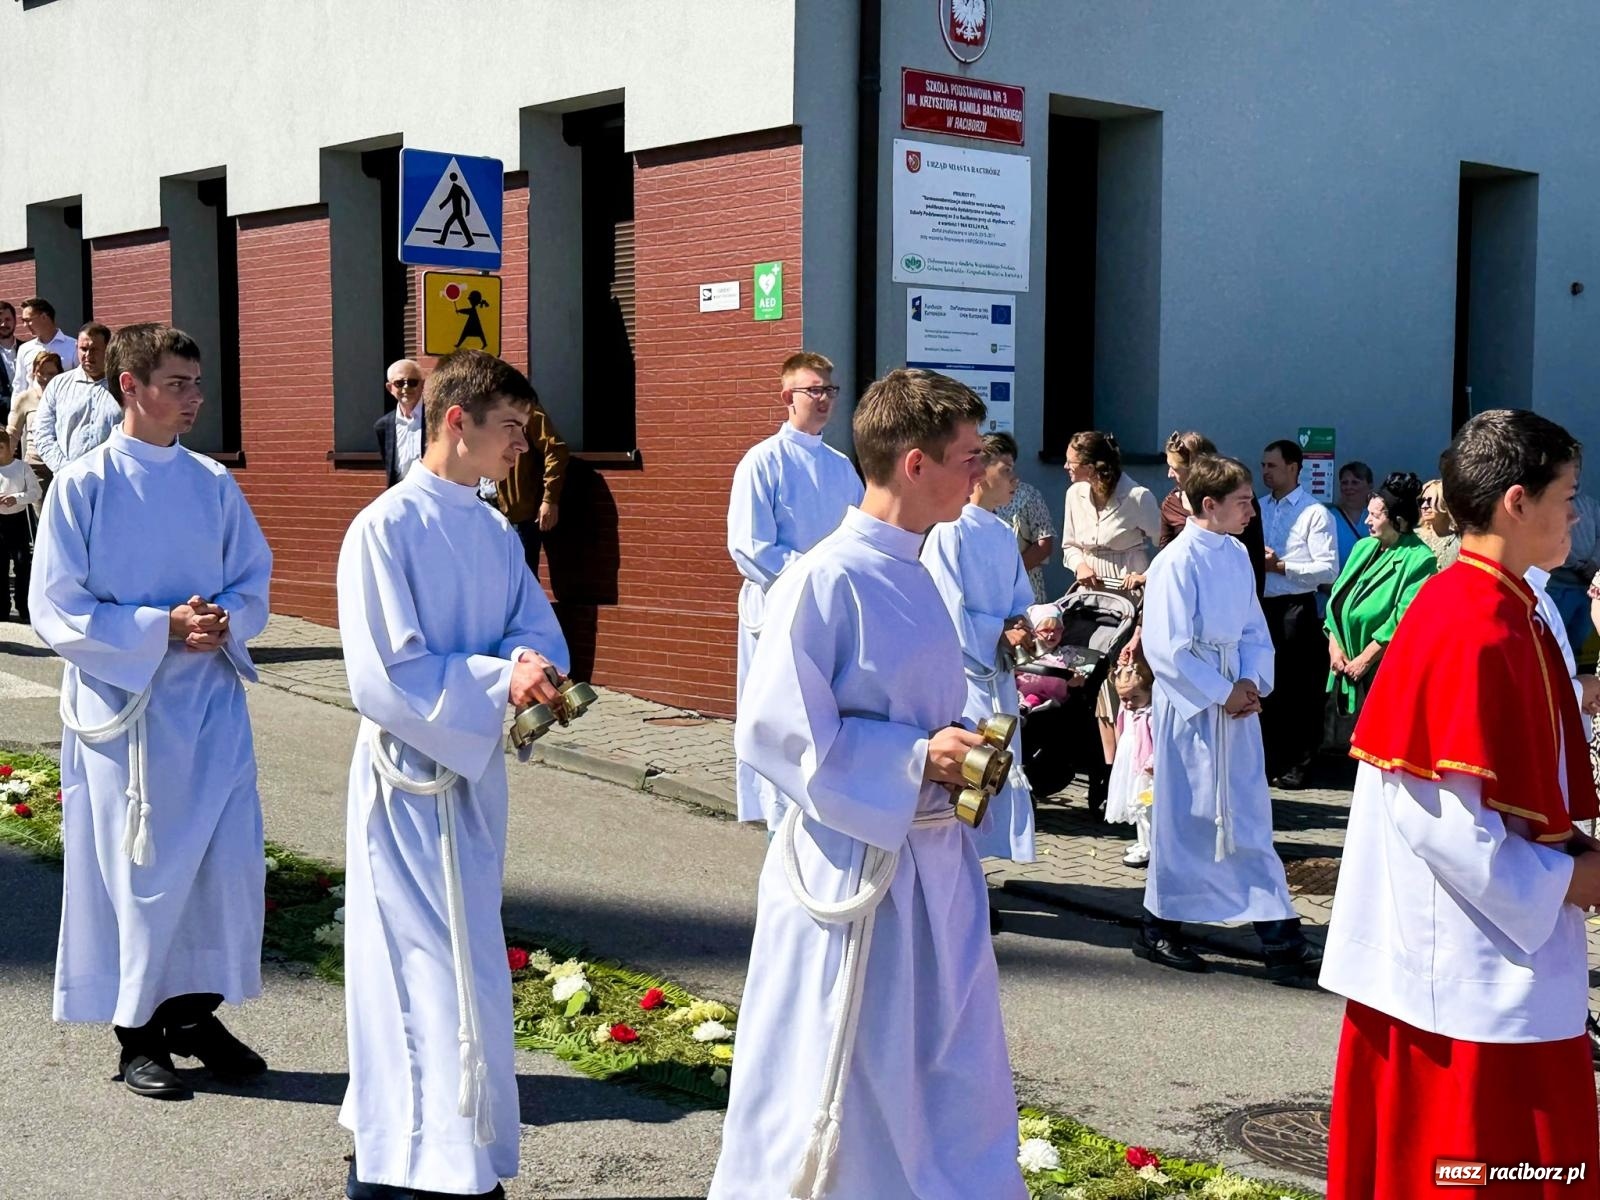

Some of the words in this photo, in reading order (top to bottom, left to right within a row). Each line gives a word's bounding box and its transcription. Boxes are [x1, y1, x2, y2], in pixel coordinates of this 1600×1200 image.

[925, 79, 949, 94] SZKOŁA
[950, 83, 992, 101] PODSTAWOWA
[993, 91, 1002, 103] NR
[907, 94, 918, 106] IM.
[919, 95, 957, 112] KRZYSZTOFA
[959, 101, 981, 116] KAMILA
[946, 116, 954, 128] W
[954, 117, 987, 133] RACIBORZU
[948, 163, 971, 173] MIASTA
[759, 297, 776, 308] AED
